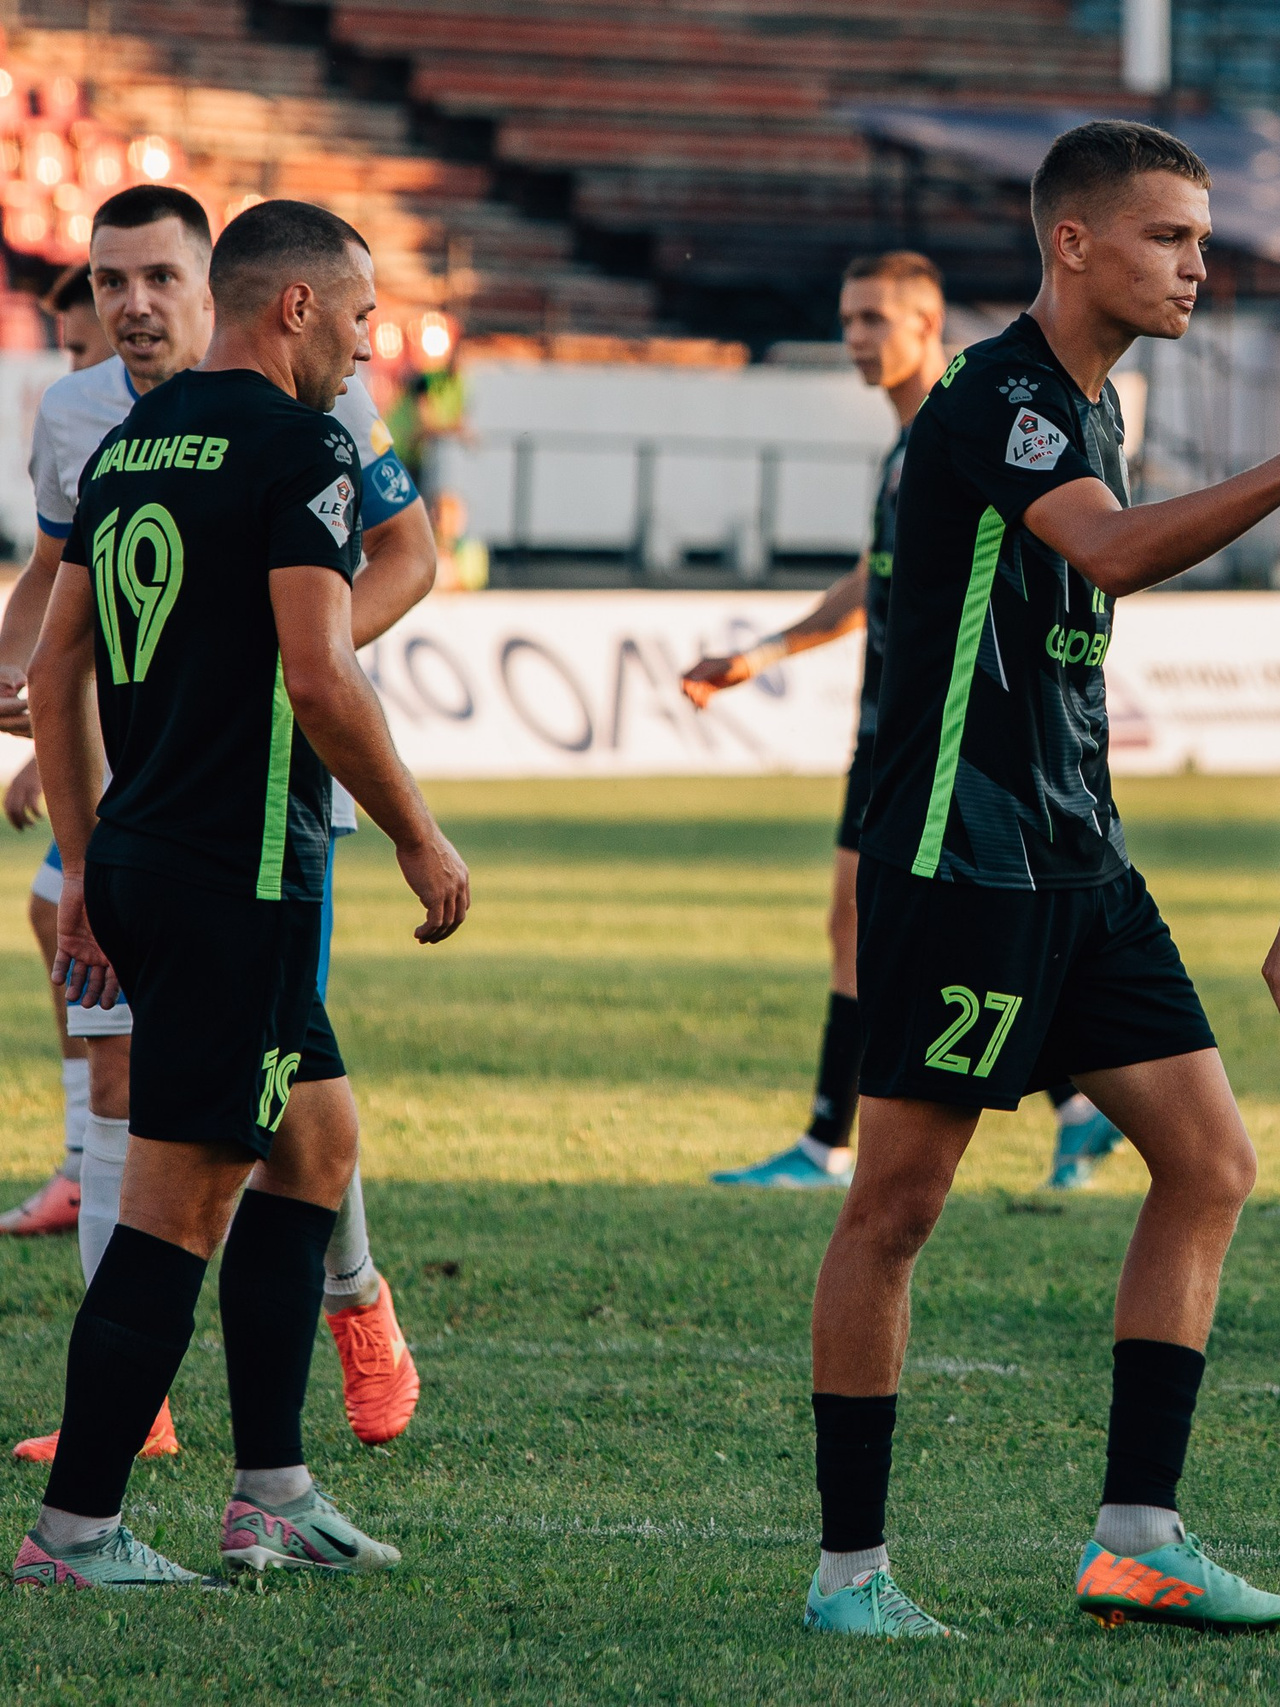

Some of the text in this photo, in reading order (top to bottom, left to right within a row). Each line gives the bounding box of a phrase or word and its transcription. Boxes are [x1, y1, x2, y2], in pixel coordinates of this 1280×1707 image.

[91, 435, 229, 481] МАШНЕВ
[1013, 433, 1060, 461] LEON
[93, 503, 184, 685] 19
[925, 985, 1023, 1078] 27
[255, 1047, 302, 1133] 19
[1077, 1551, 1206, 1609] NIKE
